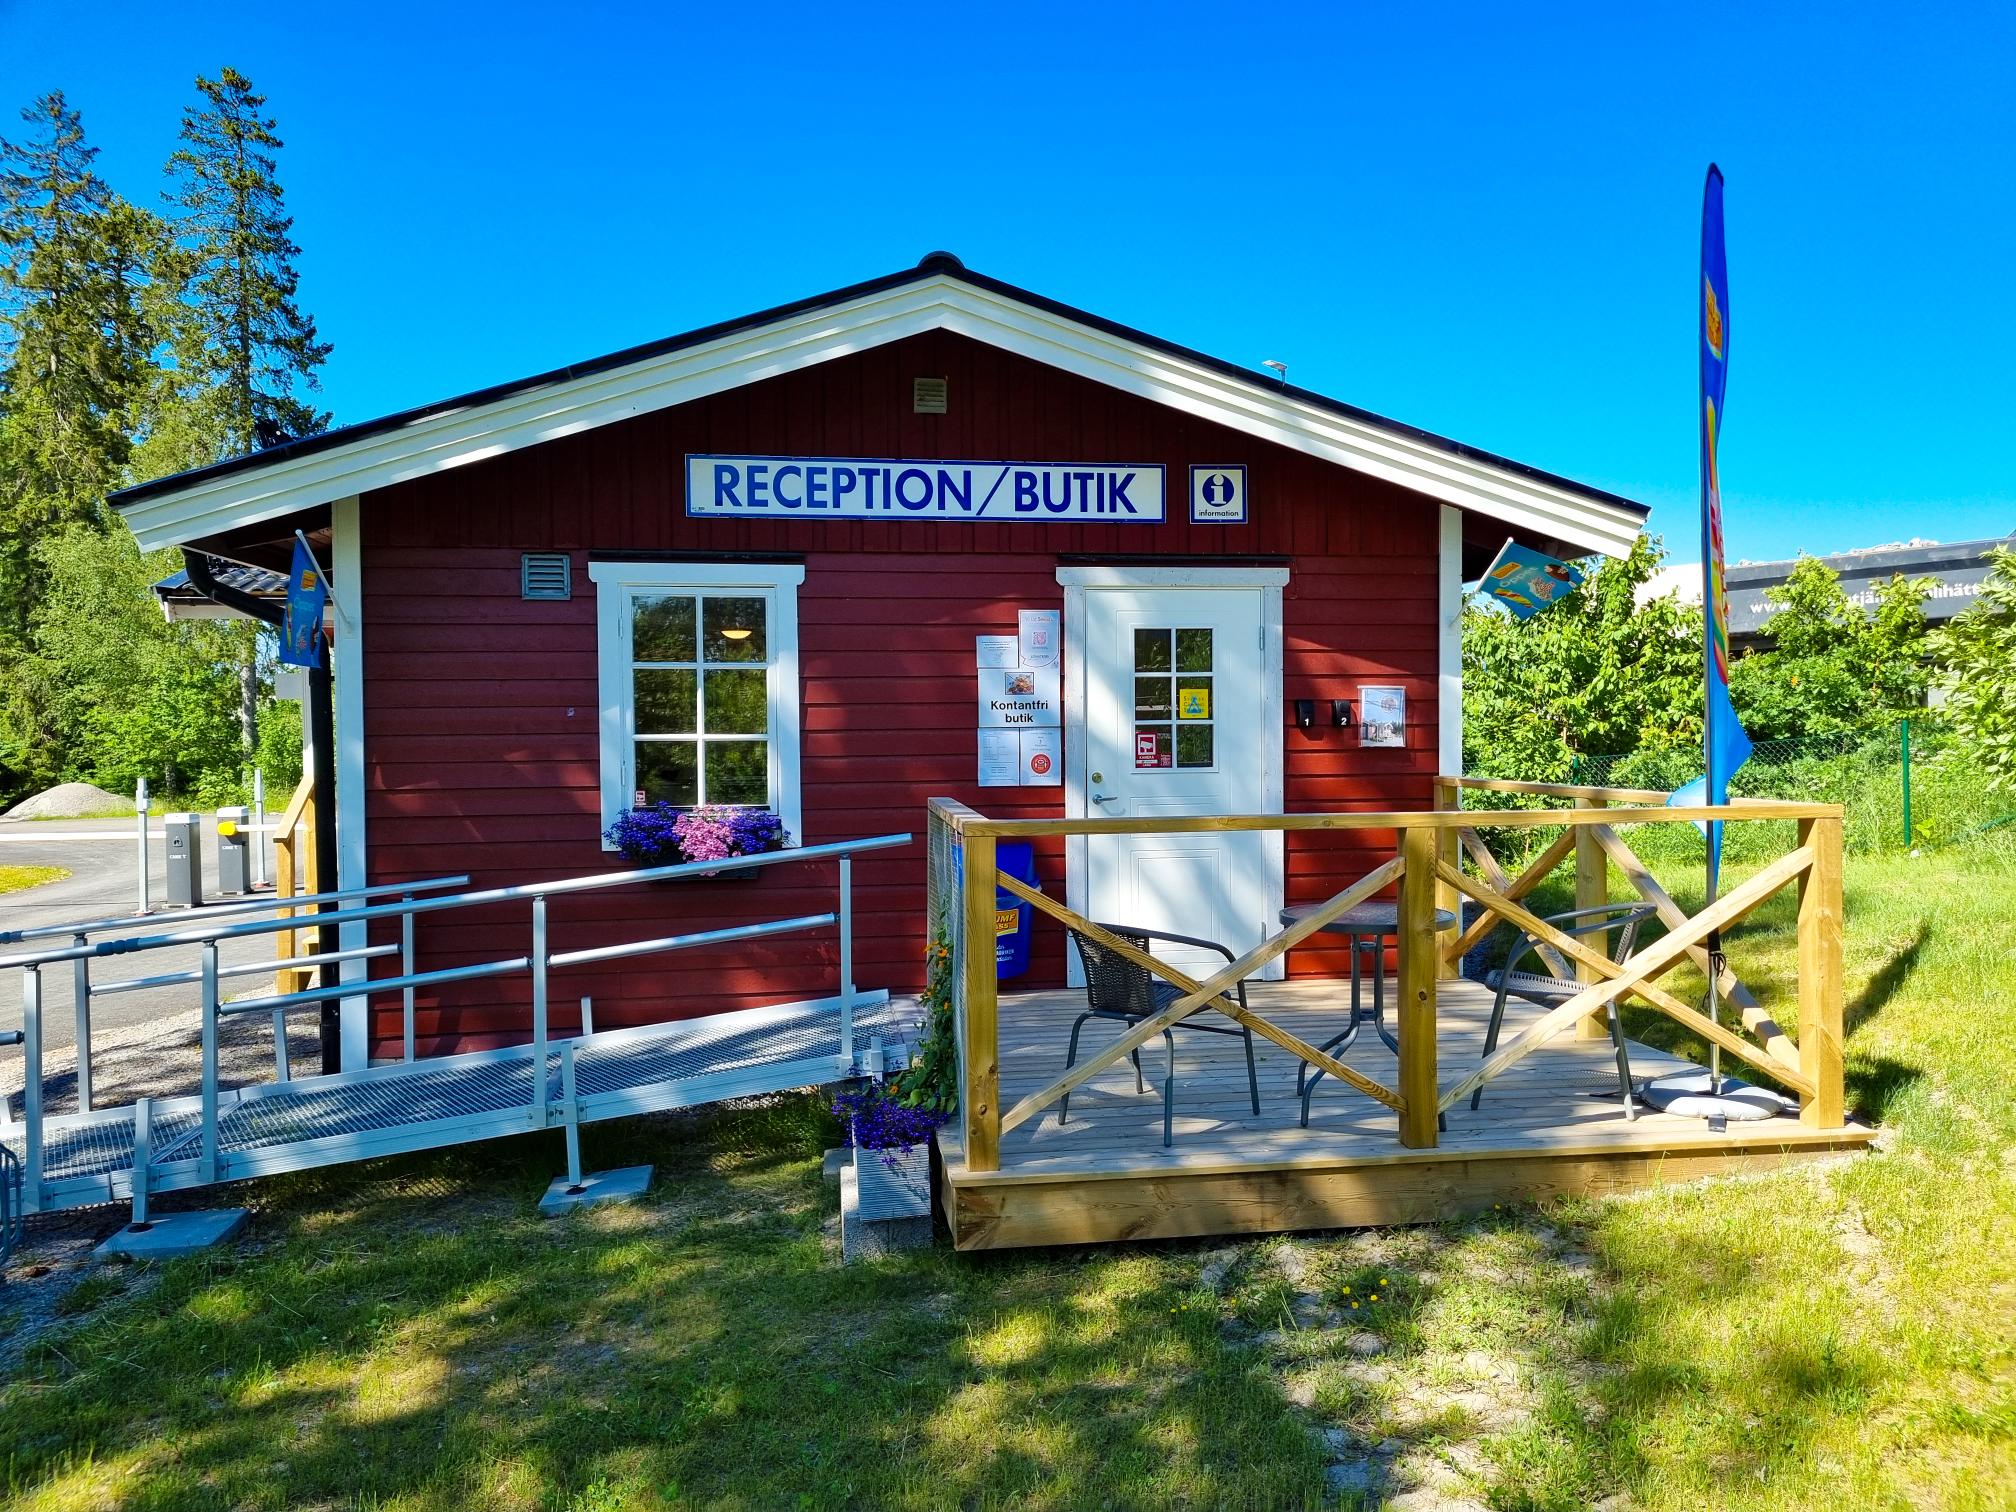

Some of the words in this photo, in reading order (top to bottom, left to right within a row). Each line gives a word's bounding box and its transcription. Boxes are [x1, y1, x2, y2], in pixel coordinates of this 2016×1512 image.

[1198, 509, 1239, 517] information
[990, 700, 1049, 710] Kontantfri
[1005, 713, 1034, 723] butik
[1304, 718, 1310, 727] 1
[1340, 717, 1347, 726] 2
